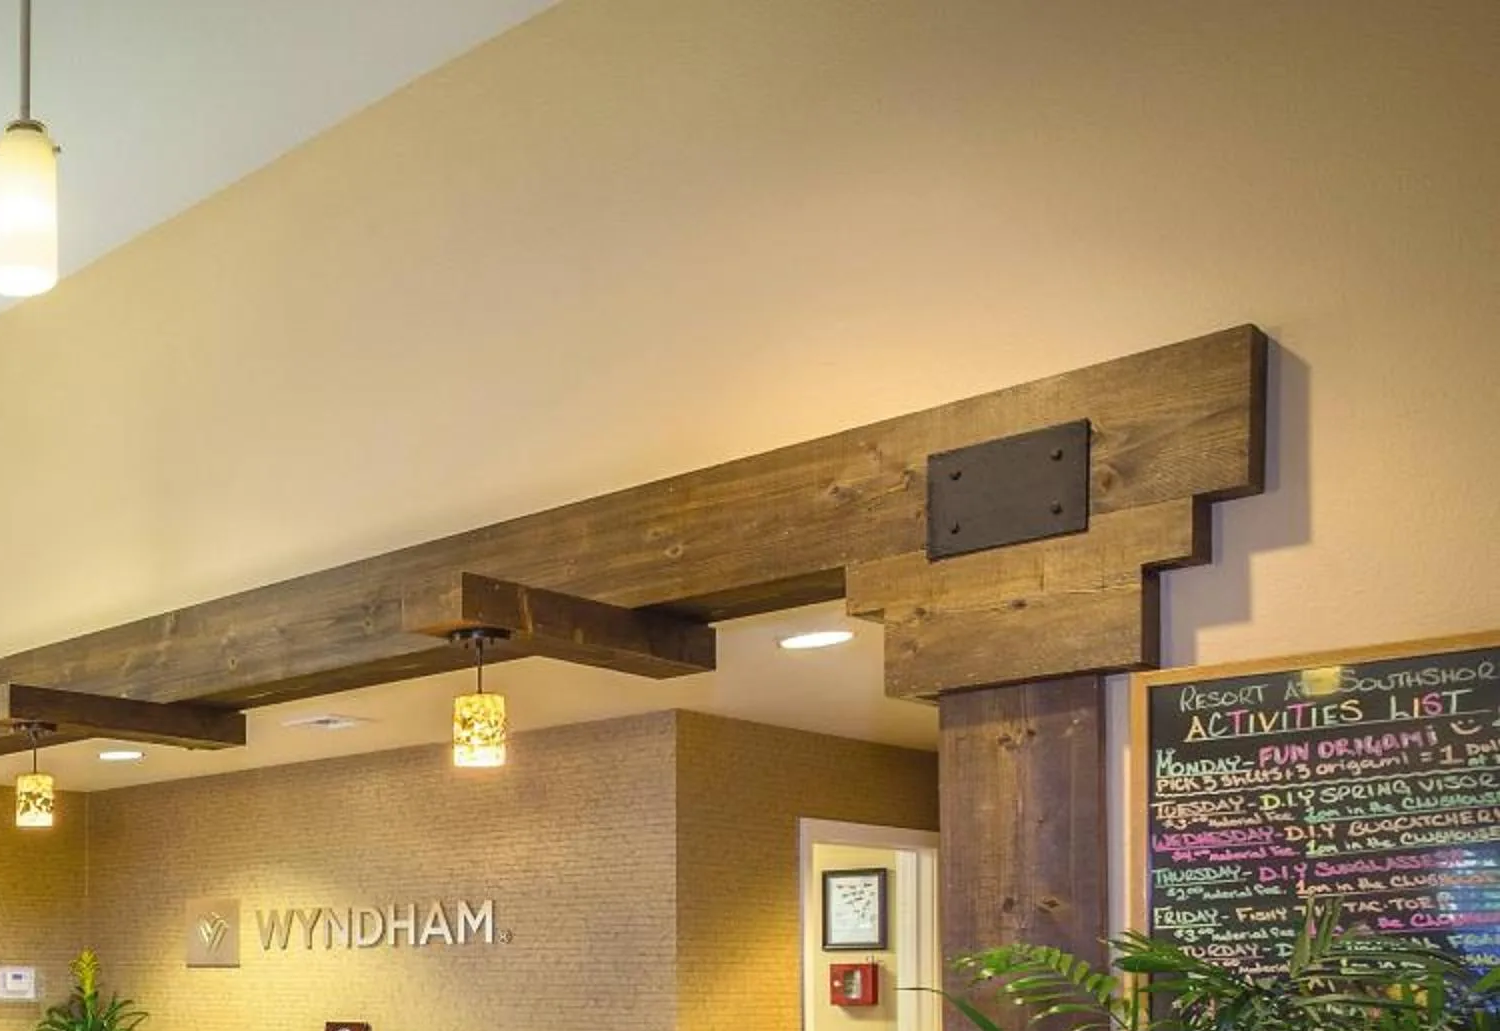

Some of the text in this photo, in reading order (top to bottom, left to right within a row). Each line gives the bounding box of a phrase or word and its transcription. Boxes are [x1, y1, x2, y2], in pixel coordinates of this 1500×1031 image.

[1179, 684, 1269, 712] RESORT
[1185, 698, 1363, 741] ACTIVITIES
[1390, 689, 1473, 721] LIST
[1259, 742, 1309, 768] FUN
[1320, 779, 1411, 803] SPRING
[256, 900, 495, 949] WYNDHAM
